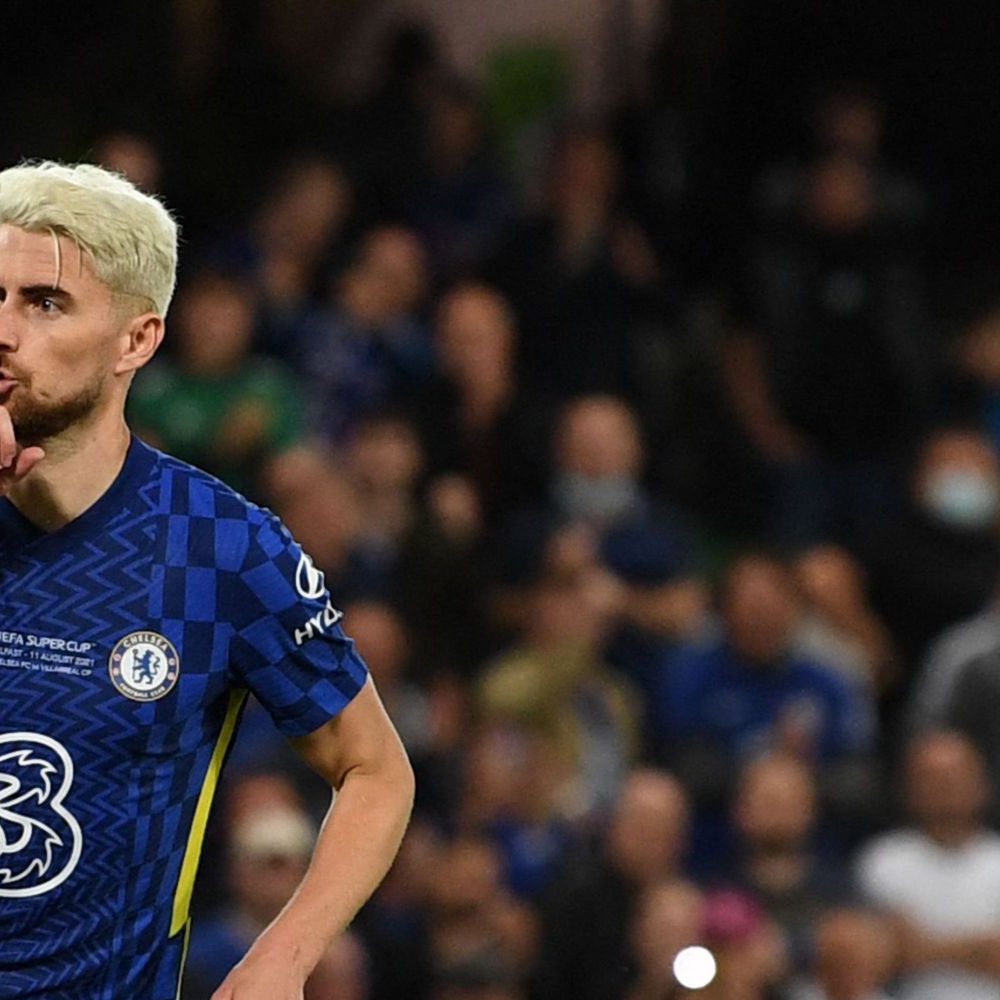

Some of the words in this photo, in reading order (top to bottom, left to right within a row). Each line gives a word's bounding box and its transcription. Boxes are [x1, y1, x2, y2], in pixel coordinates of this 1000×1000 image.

[25, 634, 66, 651] SUPER
[66, 640, 91, 653] CUP
[123, 634, 168, 651] CHELSEA
[40, 653, 74, 664] AUGUST
